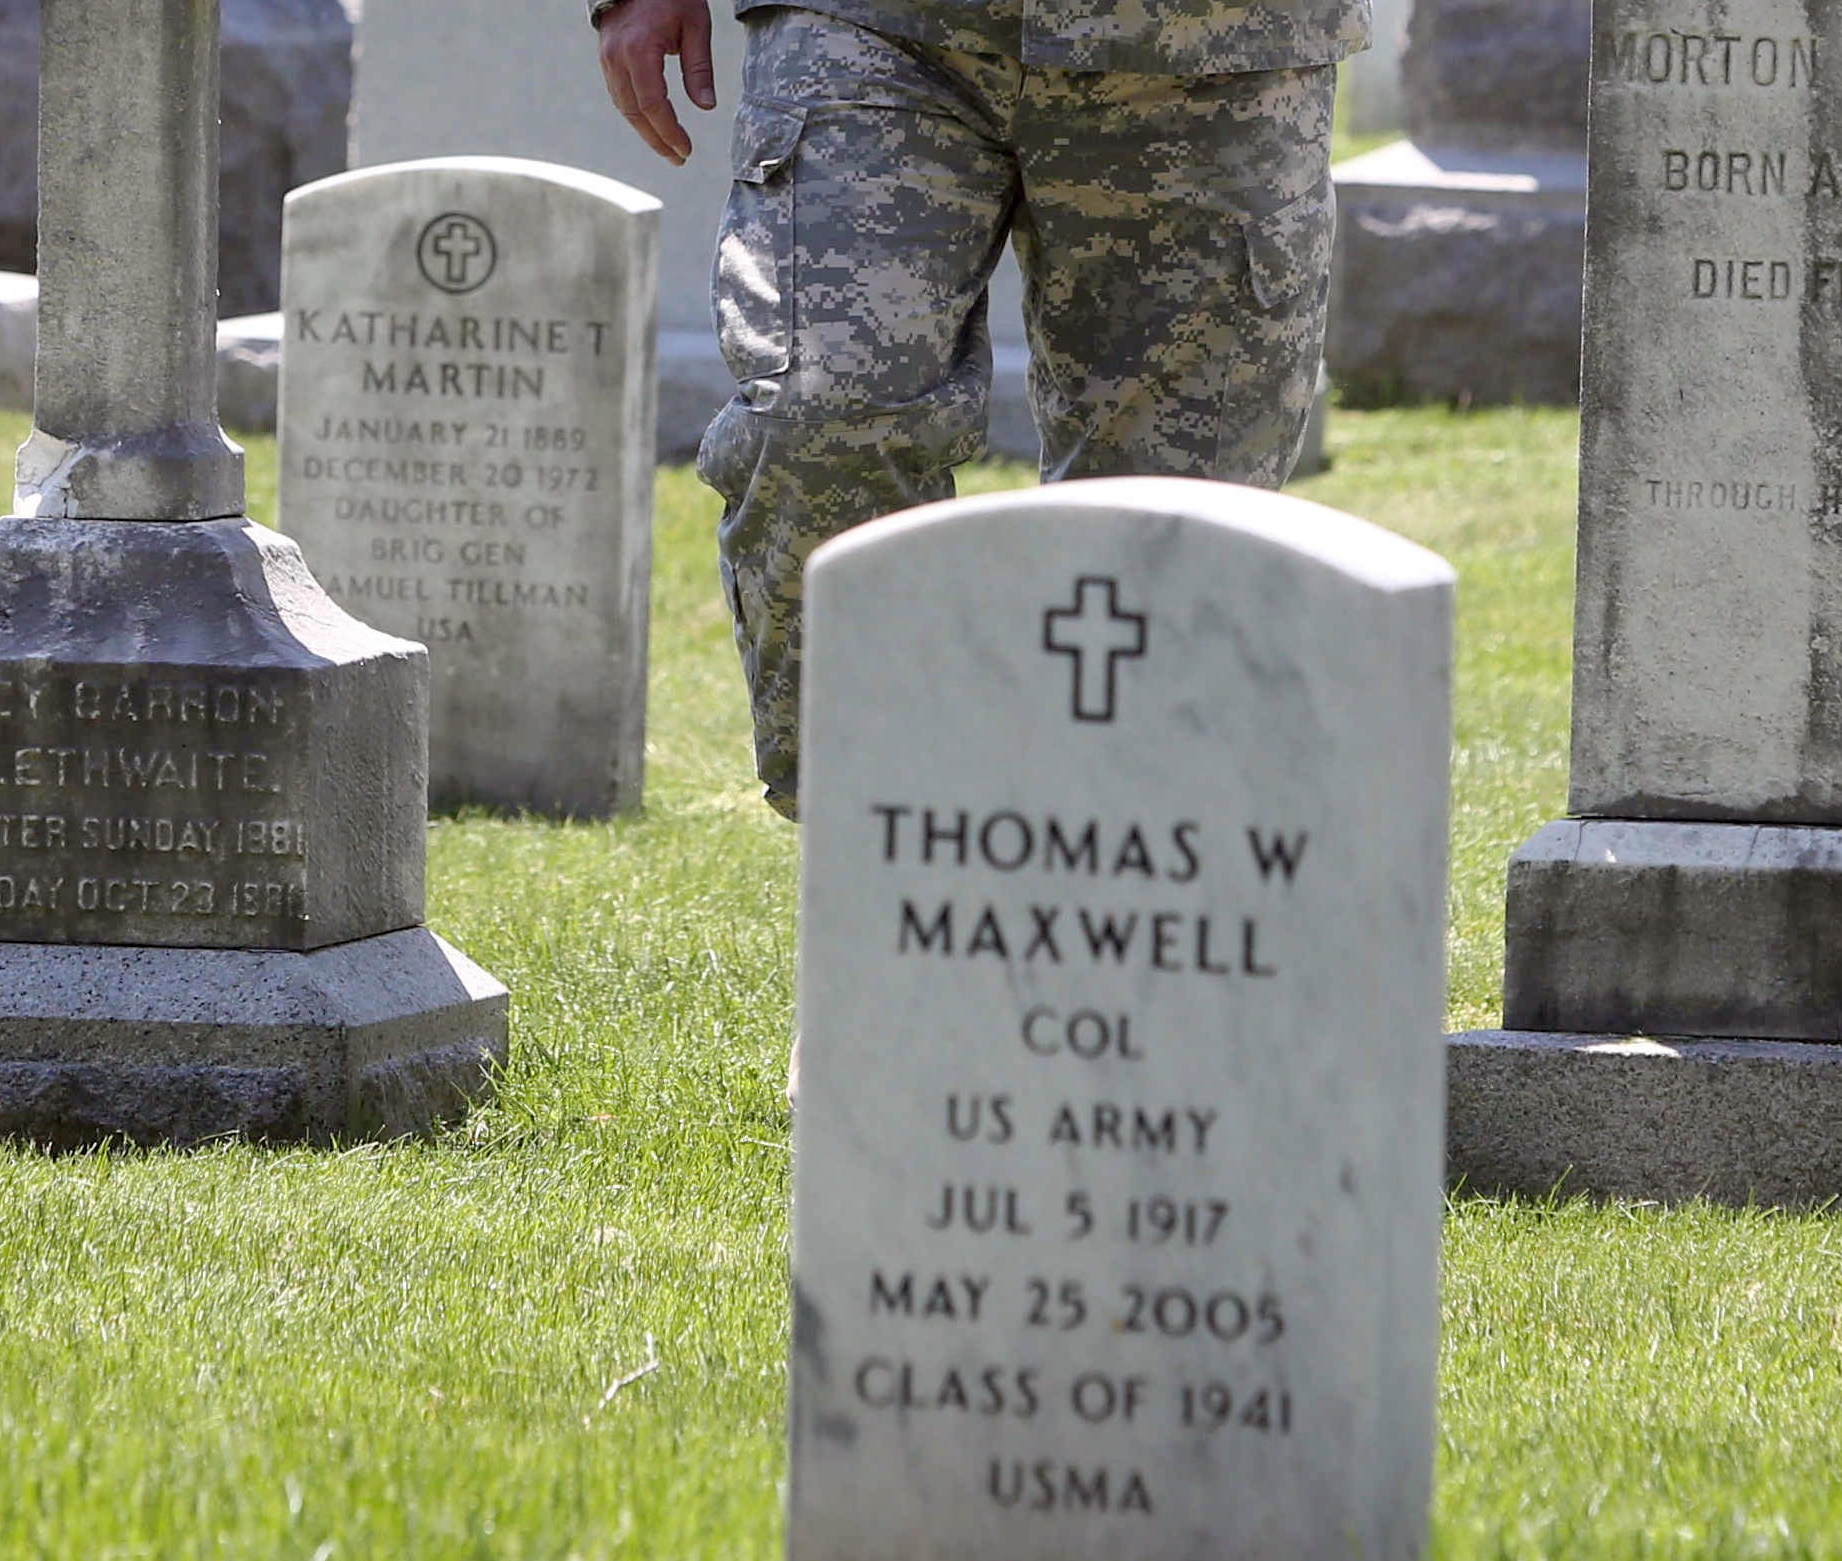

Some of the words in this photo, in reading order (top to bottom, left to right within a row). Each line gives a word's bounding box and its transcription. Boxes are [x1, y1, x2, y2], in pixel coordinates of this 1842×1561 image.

[1663, 149, 1787, 196] BORN
[1692, 258, 1793, 301] DIED
[295, 308, 569, 354] KATHARINE
[583, 320, 613, 358] T
[360, 360, 545, 400] MARTIN
[314, 416, 470, 447] JANUARY
[485, 424, 510, 448] 21
[524, 425, 588, 452] 1889
[302, 455, 467, 487] DECEMBER
[485, 462, 524, 489] 20
[537, 464, 599, 493] 1972
[1645, 479, 1796, 511] THROUGH
[334, 495, 506, 526] DAUGHTER
[523, 504, 567, 530] OF
[370, 537, 444, 565] BRIG
[459, 540, 526, 567] GEN
[328, 574, 430, 603] AMUEL
[447, 578, 590, 608] TILLMAN
[416, 617, 476, 644] USA
[81, 816, 222, 853] SUNDAY
[872, 804, 1202, 884] THOMAS
[1246, 827, 1310, 886] W
[170, 880, 216, 915] 23
[897, 899, 1278, 978] MAXWELL
[1021, 1008, 1147, 1062] COL
[945, 1094, 1015, 1144] US
[1048, 1101, 1218, 1155] ARMY
[926, 1185, 1031, 1237] JUL
[1065, 1191, 1095, 1238] 5
[1125, 1199, 1232, 1248] 1917
[869, 1270, 991, 1323] MAY
[1026, 1280, 1088, 1332] 25
[1120, 1286, 1286, 1344] 2005
[855, 1355, 1041, 1420] CLASS
[1070, 1371, 1150, 1423] OF
[1180, 1386, 1295, 1435] 1941
[987, 1458, 1153, 1516] USMA
